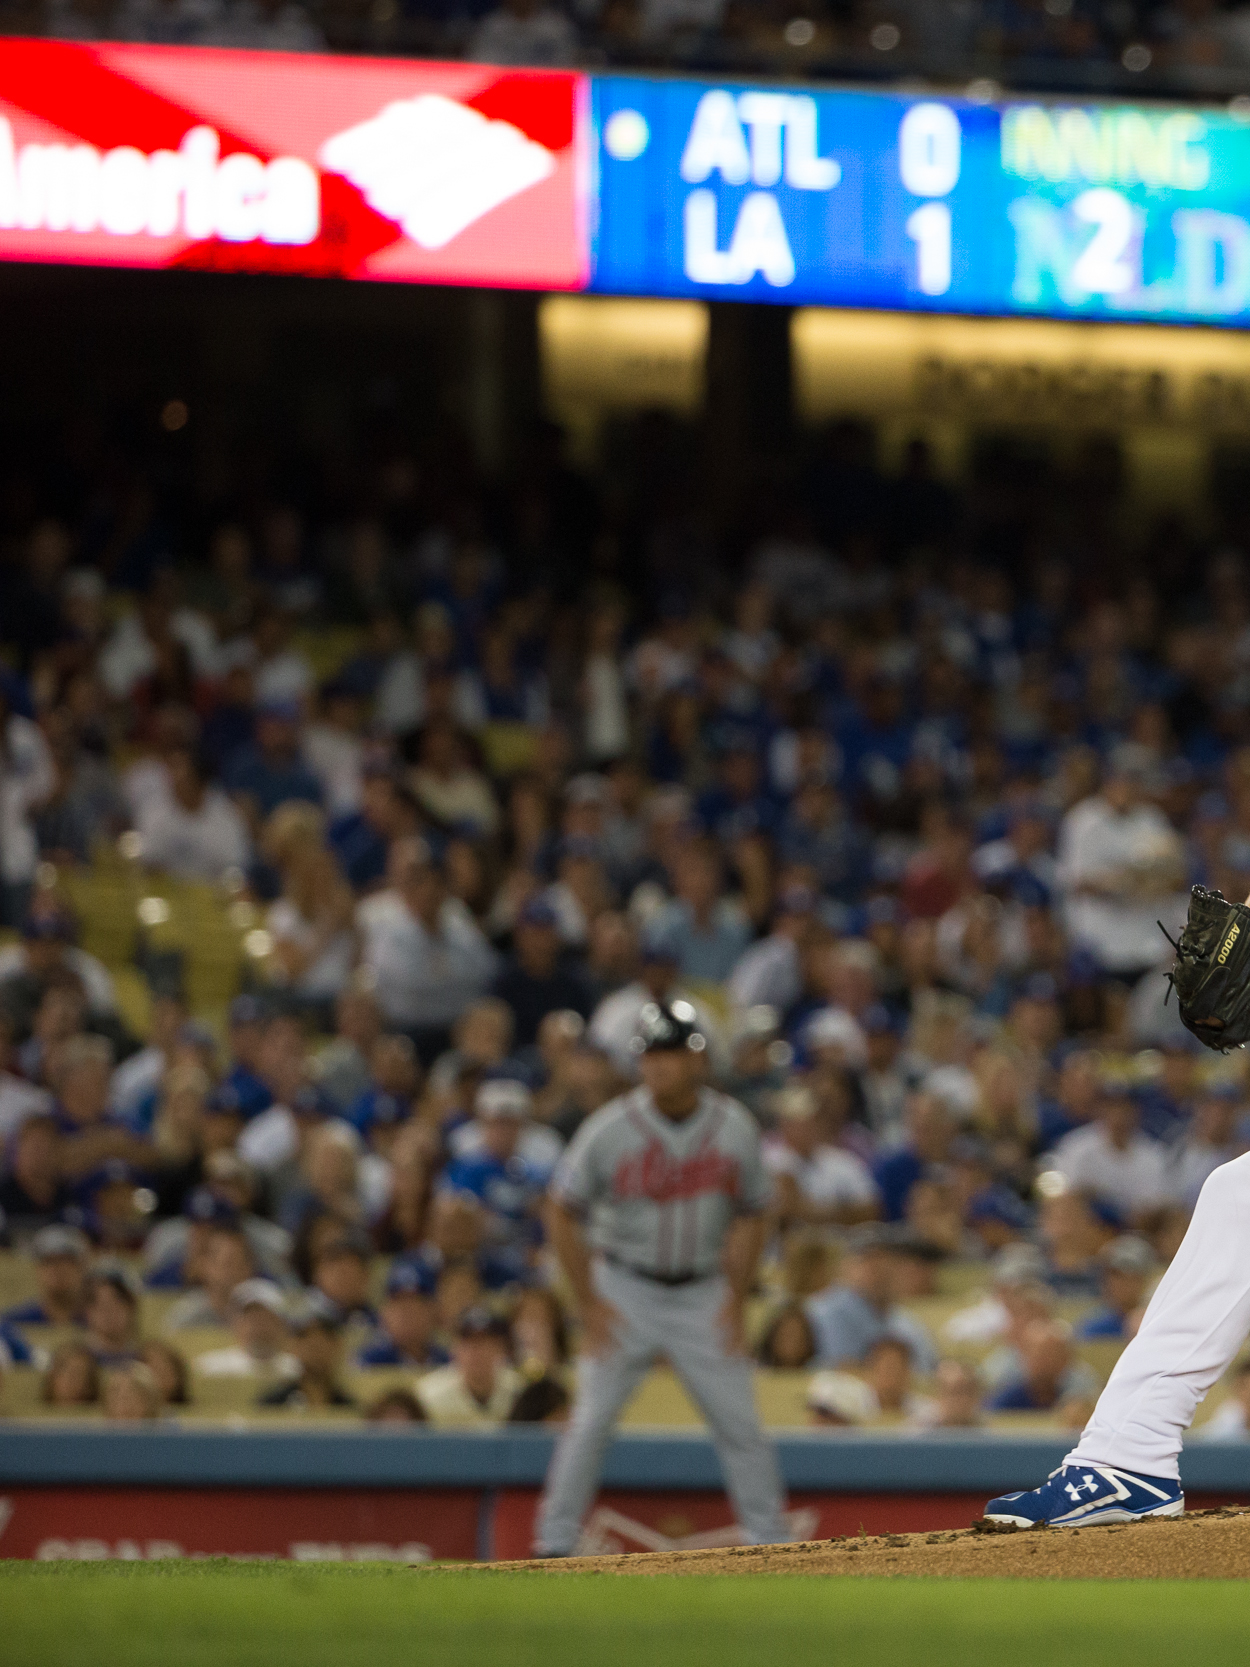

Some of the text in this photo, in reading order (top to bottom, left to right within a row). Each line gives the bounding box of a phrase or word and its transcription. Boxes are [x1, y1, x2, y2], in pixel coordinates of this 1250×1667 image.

[681, 90, 961, 197] ATL 0
[1001, 105, 1211, 190] INNING
[684, 188, 953, 295] LA 1
[1072, 187, 1134, 293] 2
[1218, 923, 1240, 964] A2000
